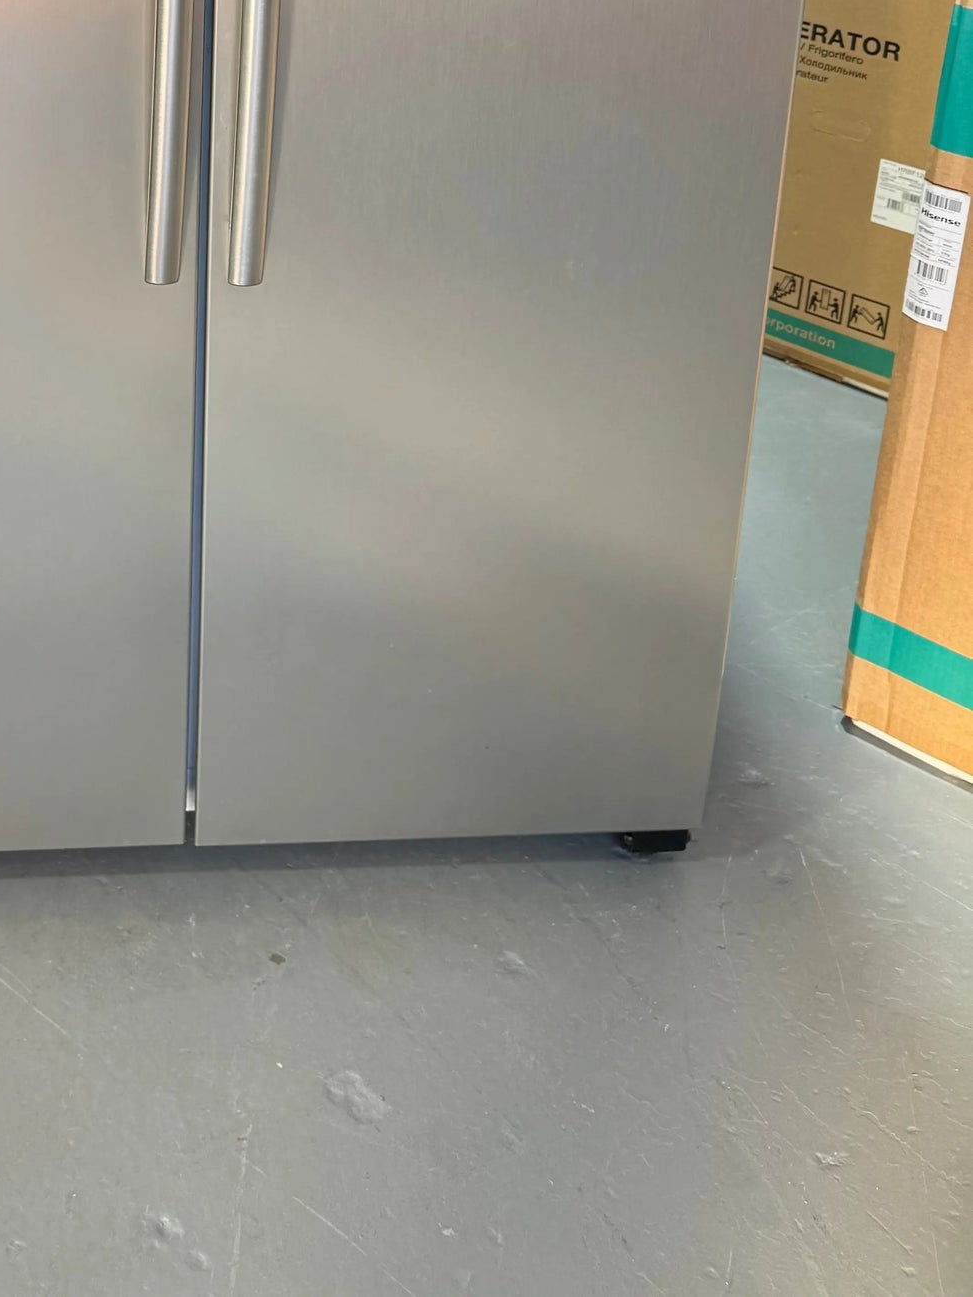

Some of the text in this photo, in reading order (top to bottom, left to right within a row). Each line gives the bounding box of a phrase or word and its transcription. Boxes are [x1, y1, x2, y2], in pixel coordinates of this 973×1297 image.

[801, 21, 900, 61] ERATOR
[808, 44, 864, 65] Frigorifero
[799, 55, 868, 80] Холодильник
[921, 207, 961, 227] Hisense
